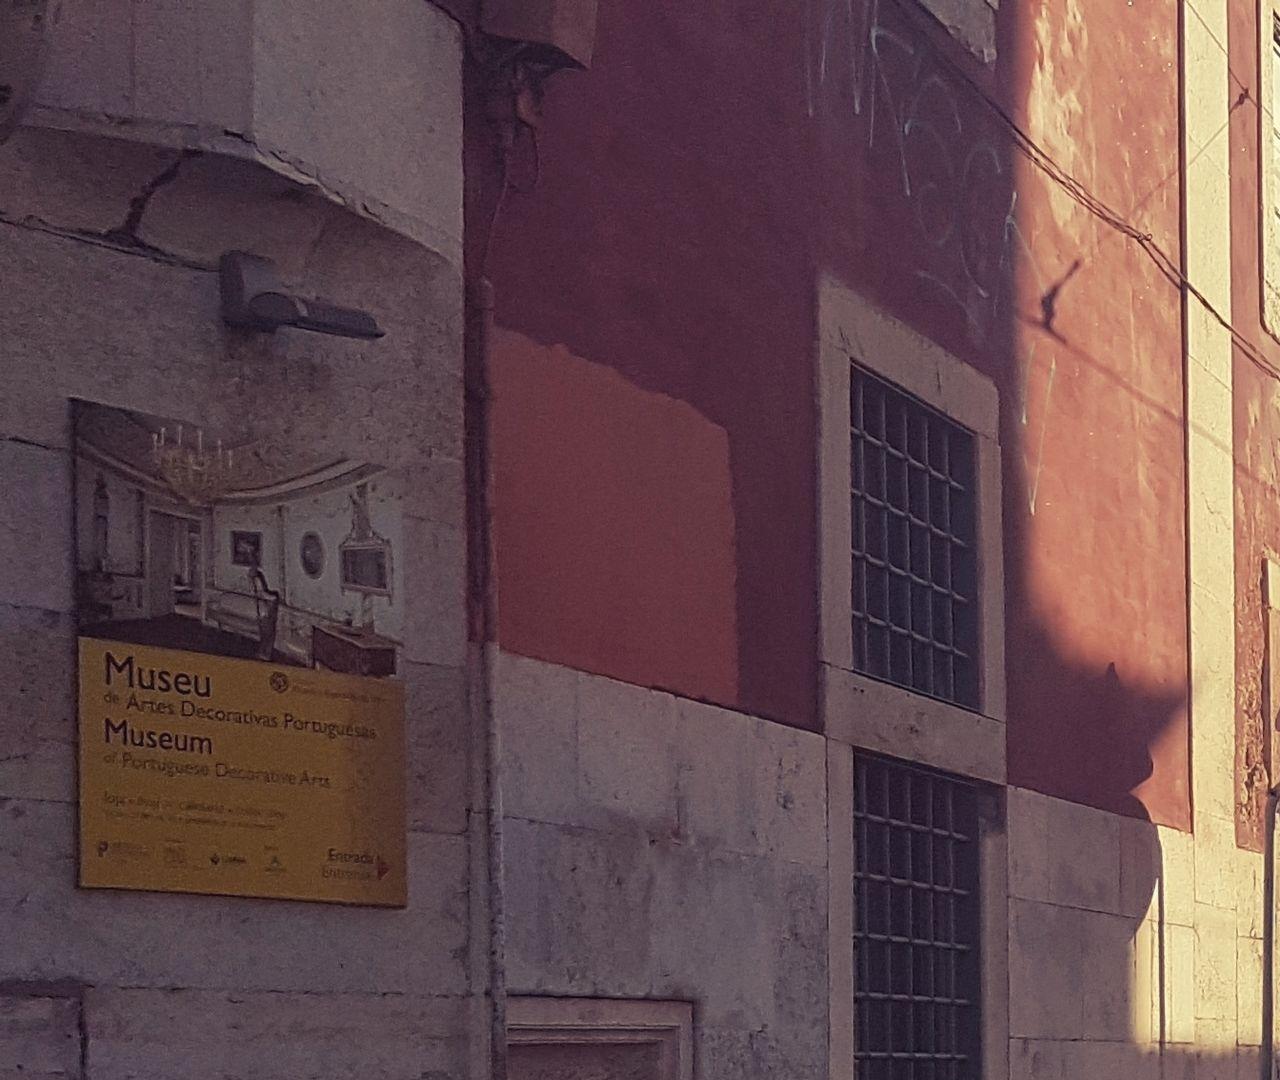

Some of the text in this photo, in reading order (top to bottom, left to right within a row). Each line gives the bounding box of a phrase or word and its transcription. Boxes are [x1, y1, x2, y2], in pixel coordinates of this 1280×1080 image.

[104, 651, 212, 698] Museu
[126, 693, 176, 716] Artes
[181, 700, 278, 729] Decorativas
[104, 717, 213, 755] Museum
[122, 752, 210, 778] Portuguese
[215, 763, 297, 785] Decorative
[299, 770, 331, 788] Arts
